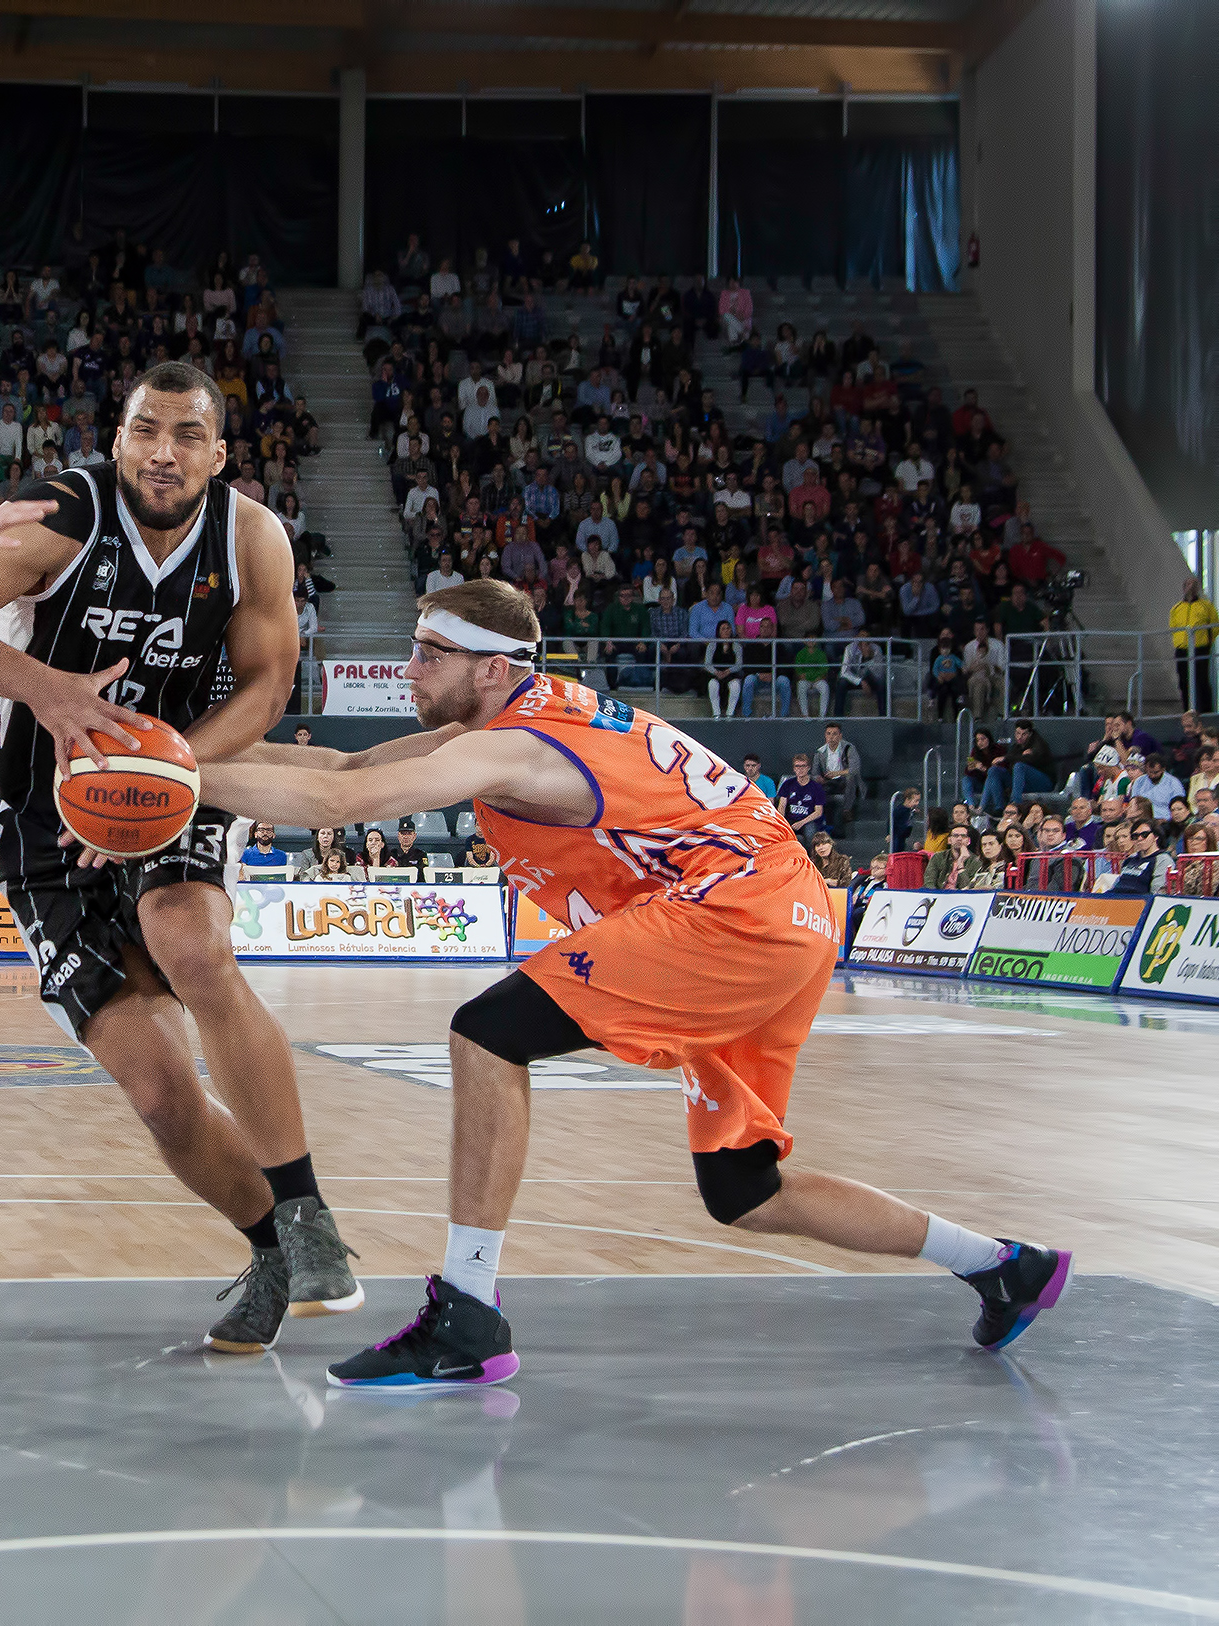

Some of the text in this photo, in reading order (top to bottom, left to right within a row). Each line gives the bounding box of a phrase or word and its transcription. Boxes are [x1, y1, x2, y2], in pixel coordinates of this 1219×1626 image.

[144, 646, 205, 669] bet.es
[333, 663, 406, 679] PALENC
[356, 705, 373, 713] José
[85, 785, 170, 807] molten
[943, 910, 971, 934] Ford
[1190, 913, 1219, 948] IN
[288, 943, 335, 953] Luminosos
[338, 942, 375, 953] Rótulos
[377, 943, 417, 953] Palencia
[443, 944, 459, 953] 979
[462, 945, 477, 953] 711
[480, 945, 497, 953] 874
[1053, 926, 1135, 957] MODOS
